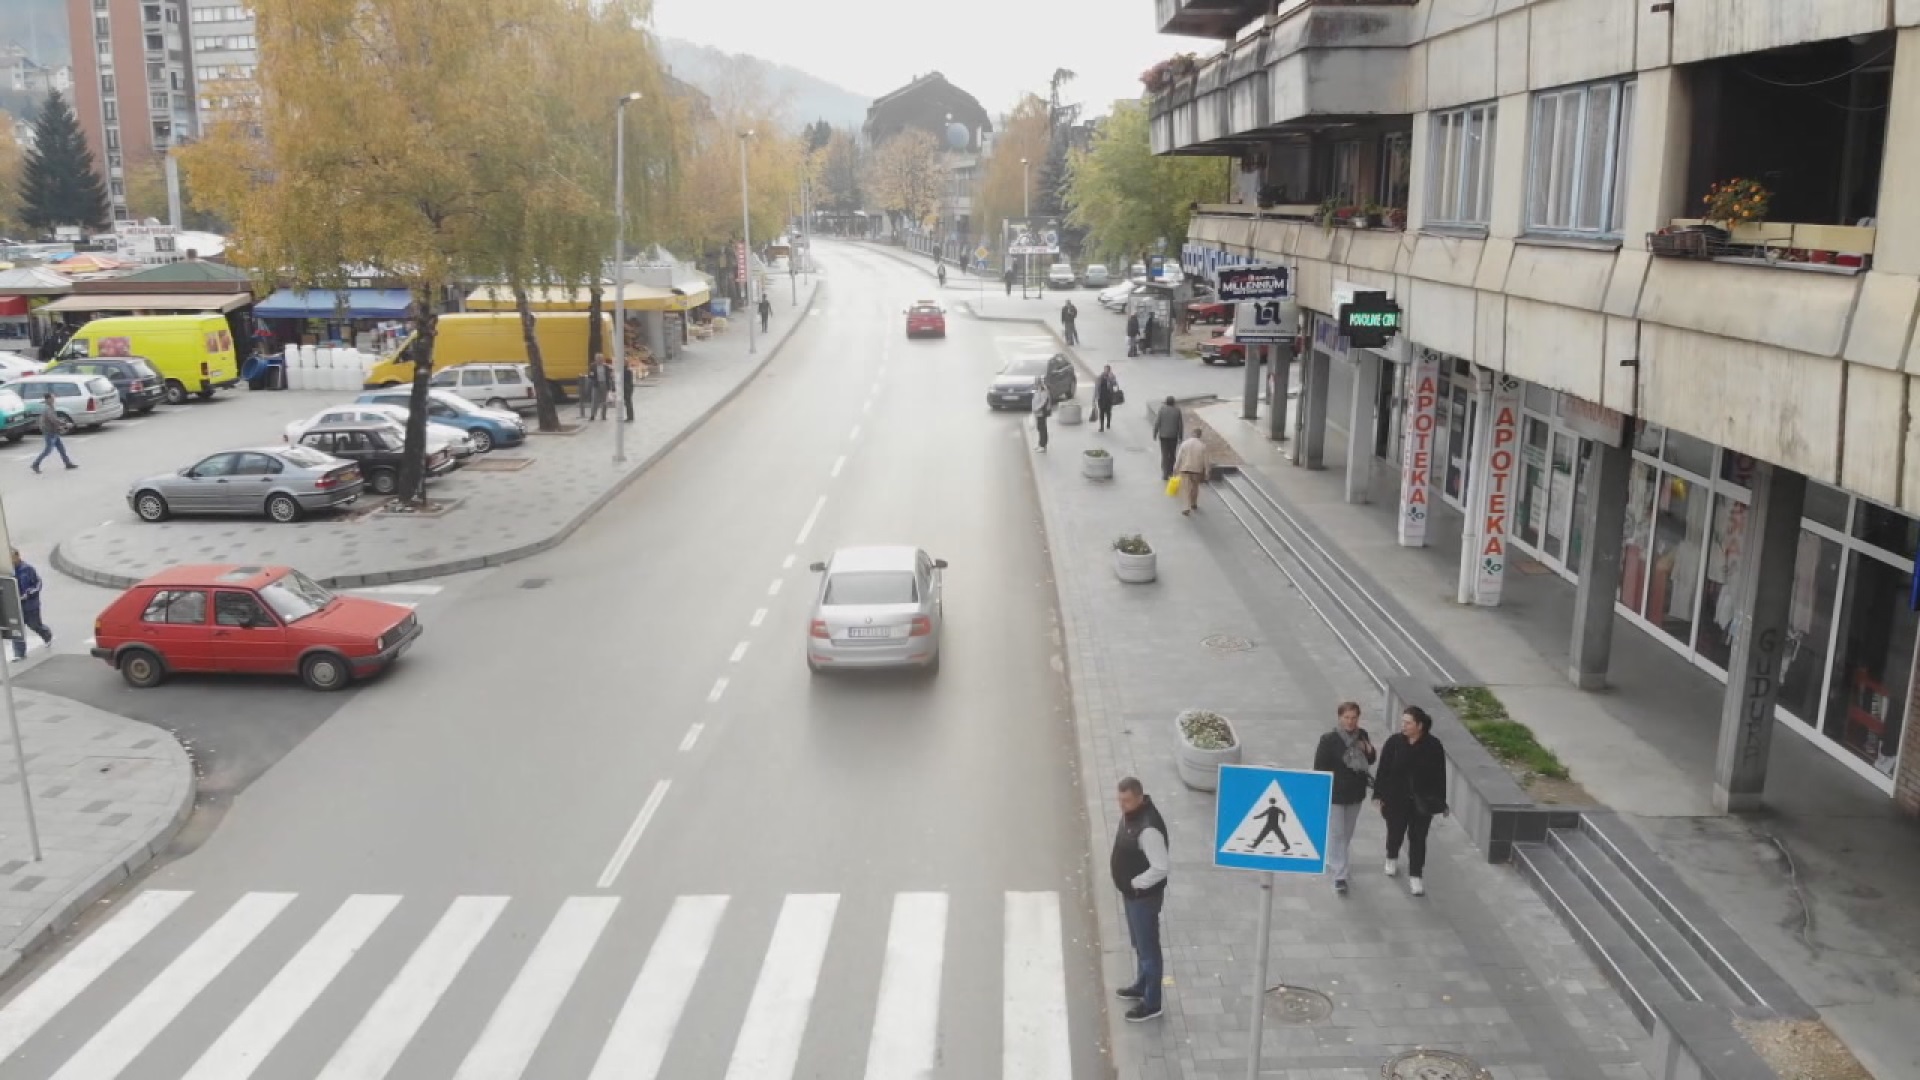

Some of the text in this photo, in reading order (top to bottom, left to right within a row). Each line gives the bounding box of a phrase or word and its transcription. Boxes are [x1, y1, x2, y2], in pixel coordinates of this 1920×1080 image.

[1223, 279, 1284, 292] MILLENNIUM
[1410, 377, 1434, 504] APOTEKA
[1484, 407, 1514, 555] APOTEKA
